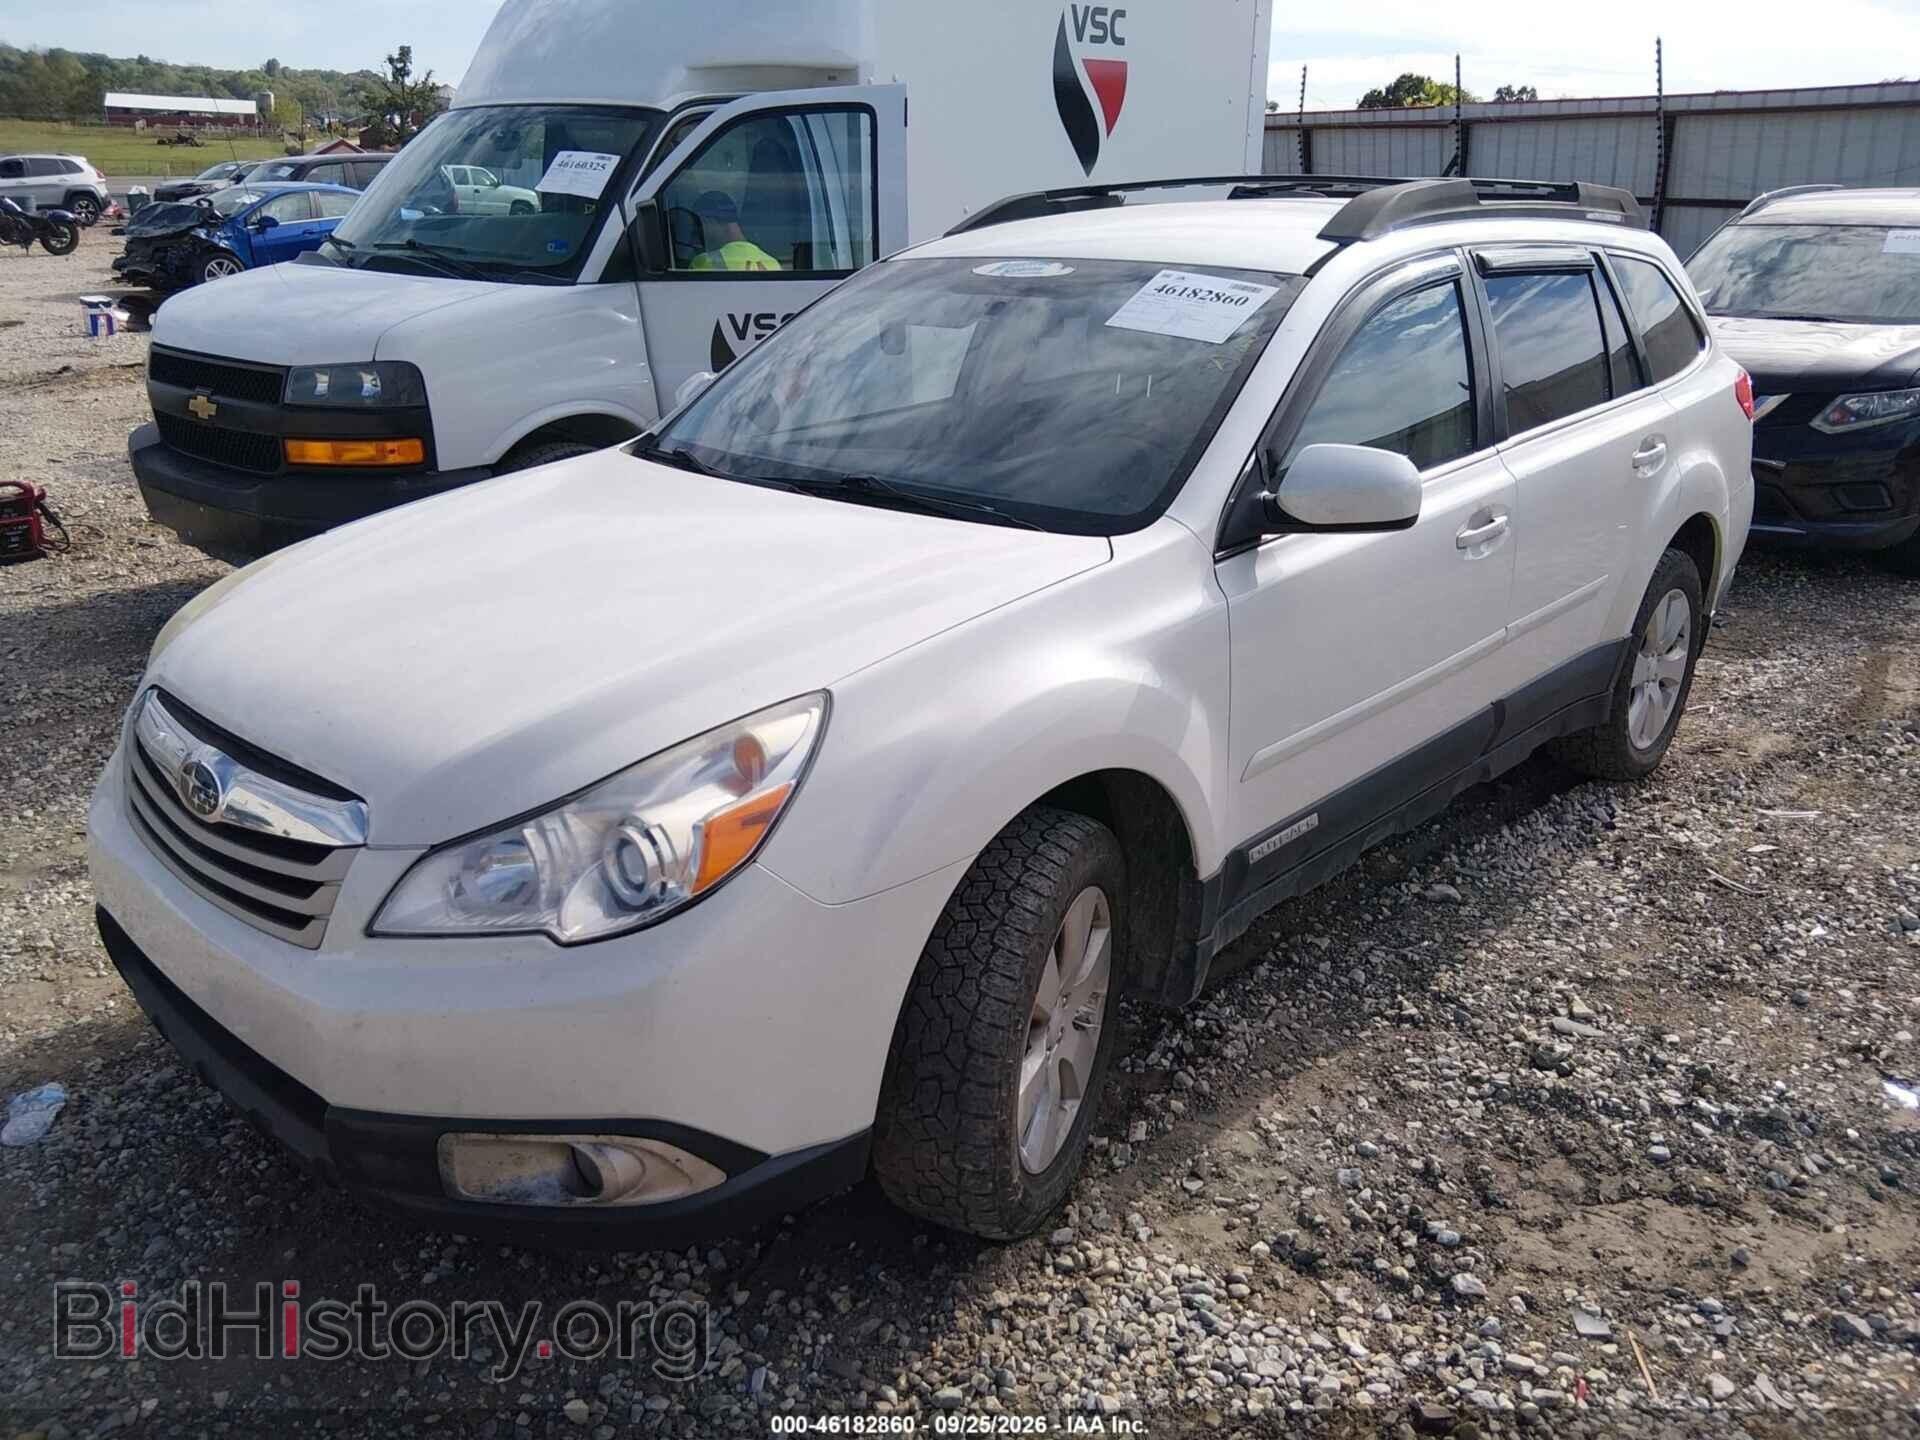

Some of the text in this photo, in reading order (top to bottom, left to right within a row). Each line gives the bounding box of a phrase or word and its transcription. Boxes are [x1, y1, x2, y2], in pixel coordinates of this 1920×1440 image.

[1071, 4, 1126, 46] VSC
[1153, 283, 1249, 306] 46182860
[727, 313, 797, 341] VS
